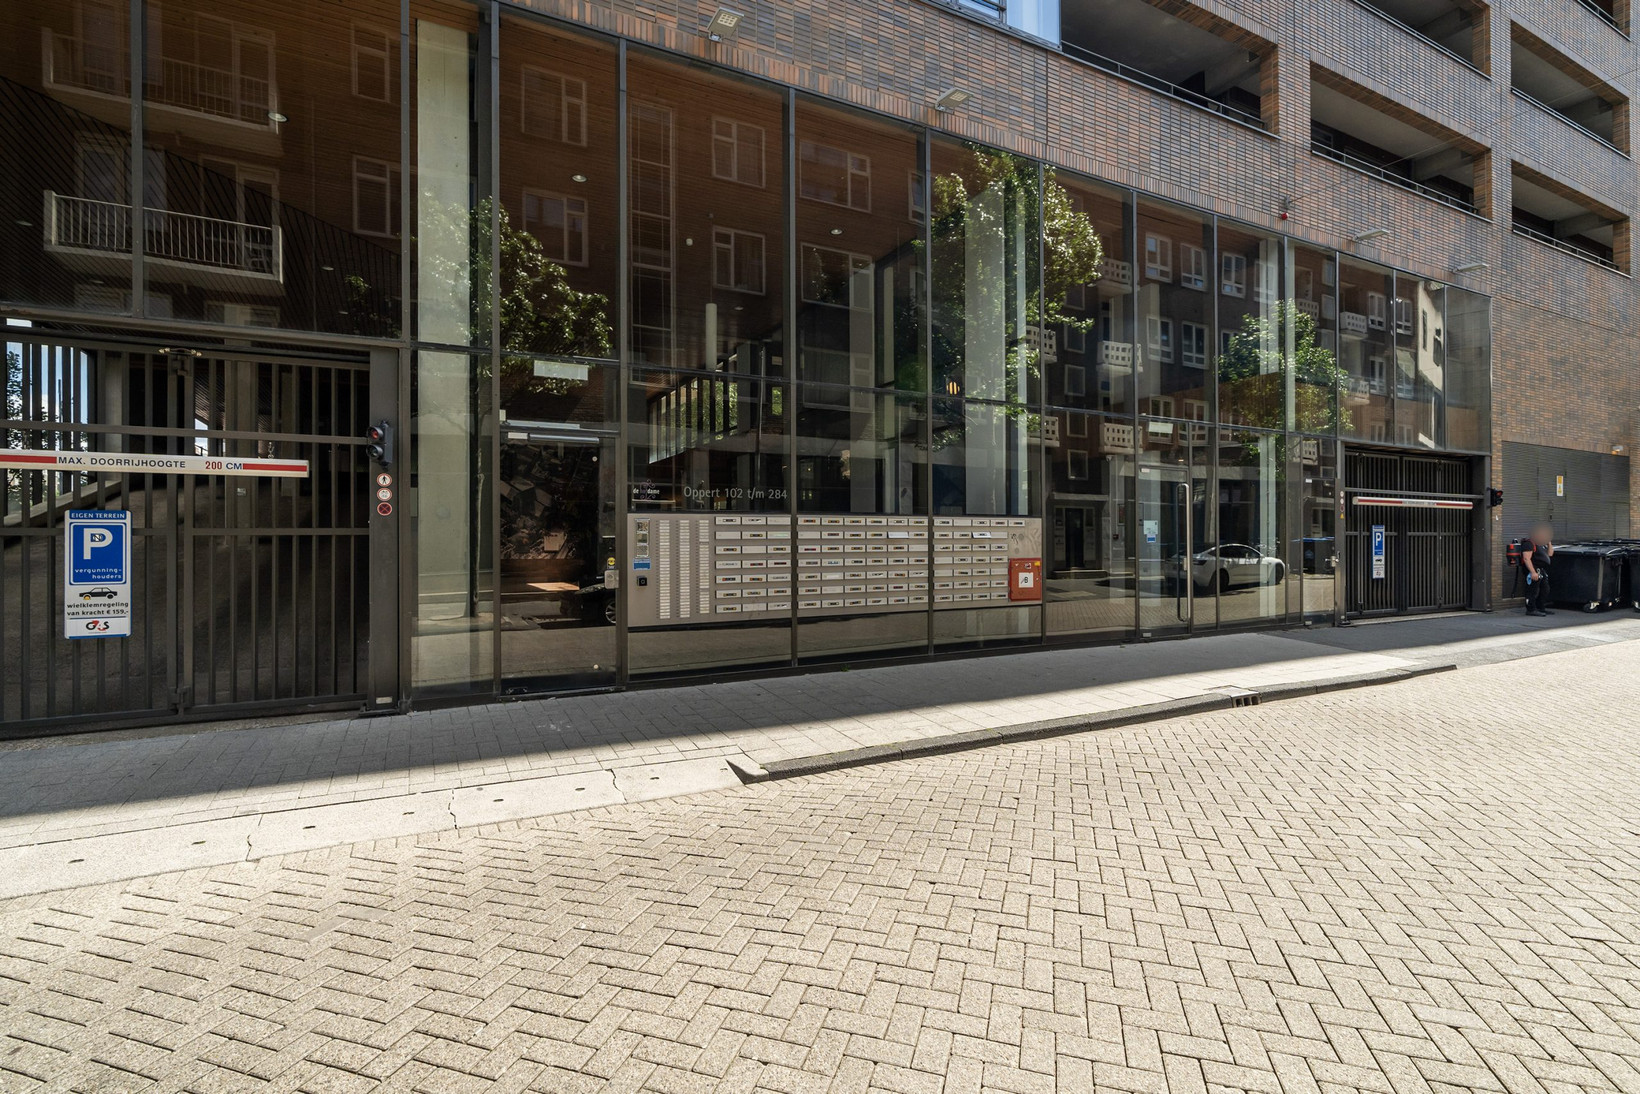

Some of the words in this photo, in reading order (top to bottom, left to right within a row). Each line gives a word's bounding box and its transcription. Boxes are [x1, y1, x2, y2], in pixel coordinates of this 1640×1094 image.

[58, 456, 86, 465] MAX.
[90, 457, 186, 469] DOORRIJHOOGTE
[205, 460, 223, 470] 200
[225, 462, 243, 470] CM
[683, 486, 720, 499] Oppert
[725, 488, 743, 498] 102
[747, 487, 764, 499] t/m
[768, 488, 788, 499] 284
[83, 527, 113, 560] P
[1375, 532, 1382, 547] P
